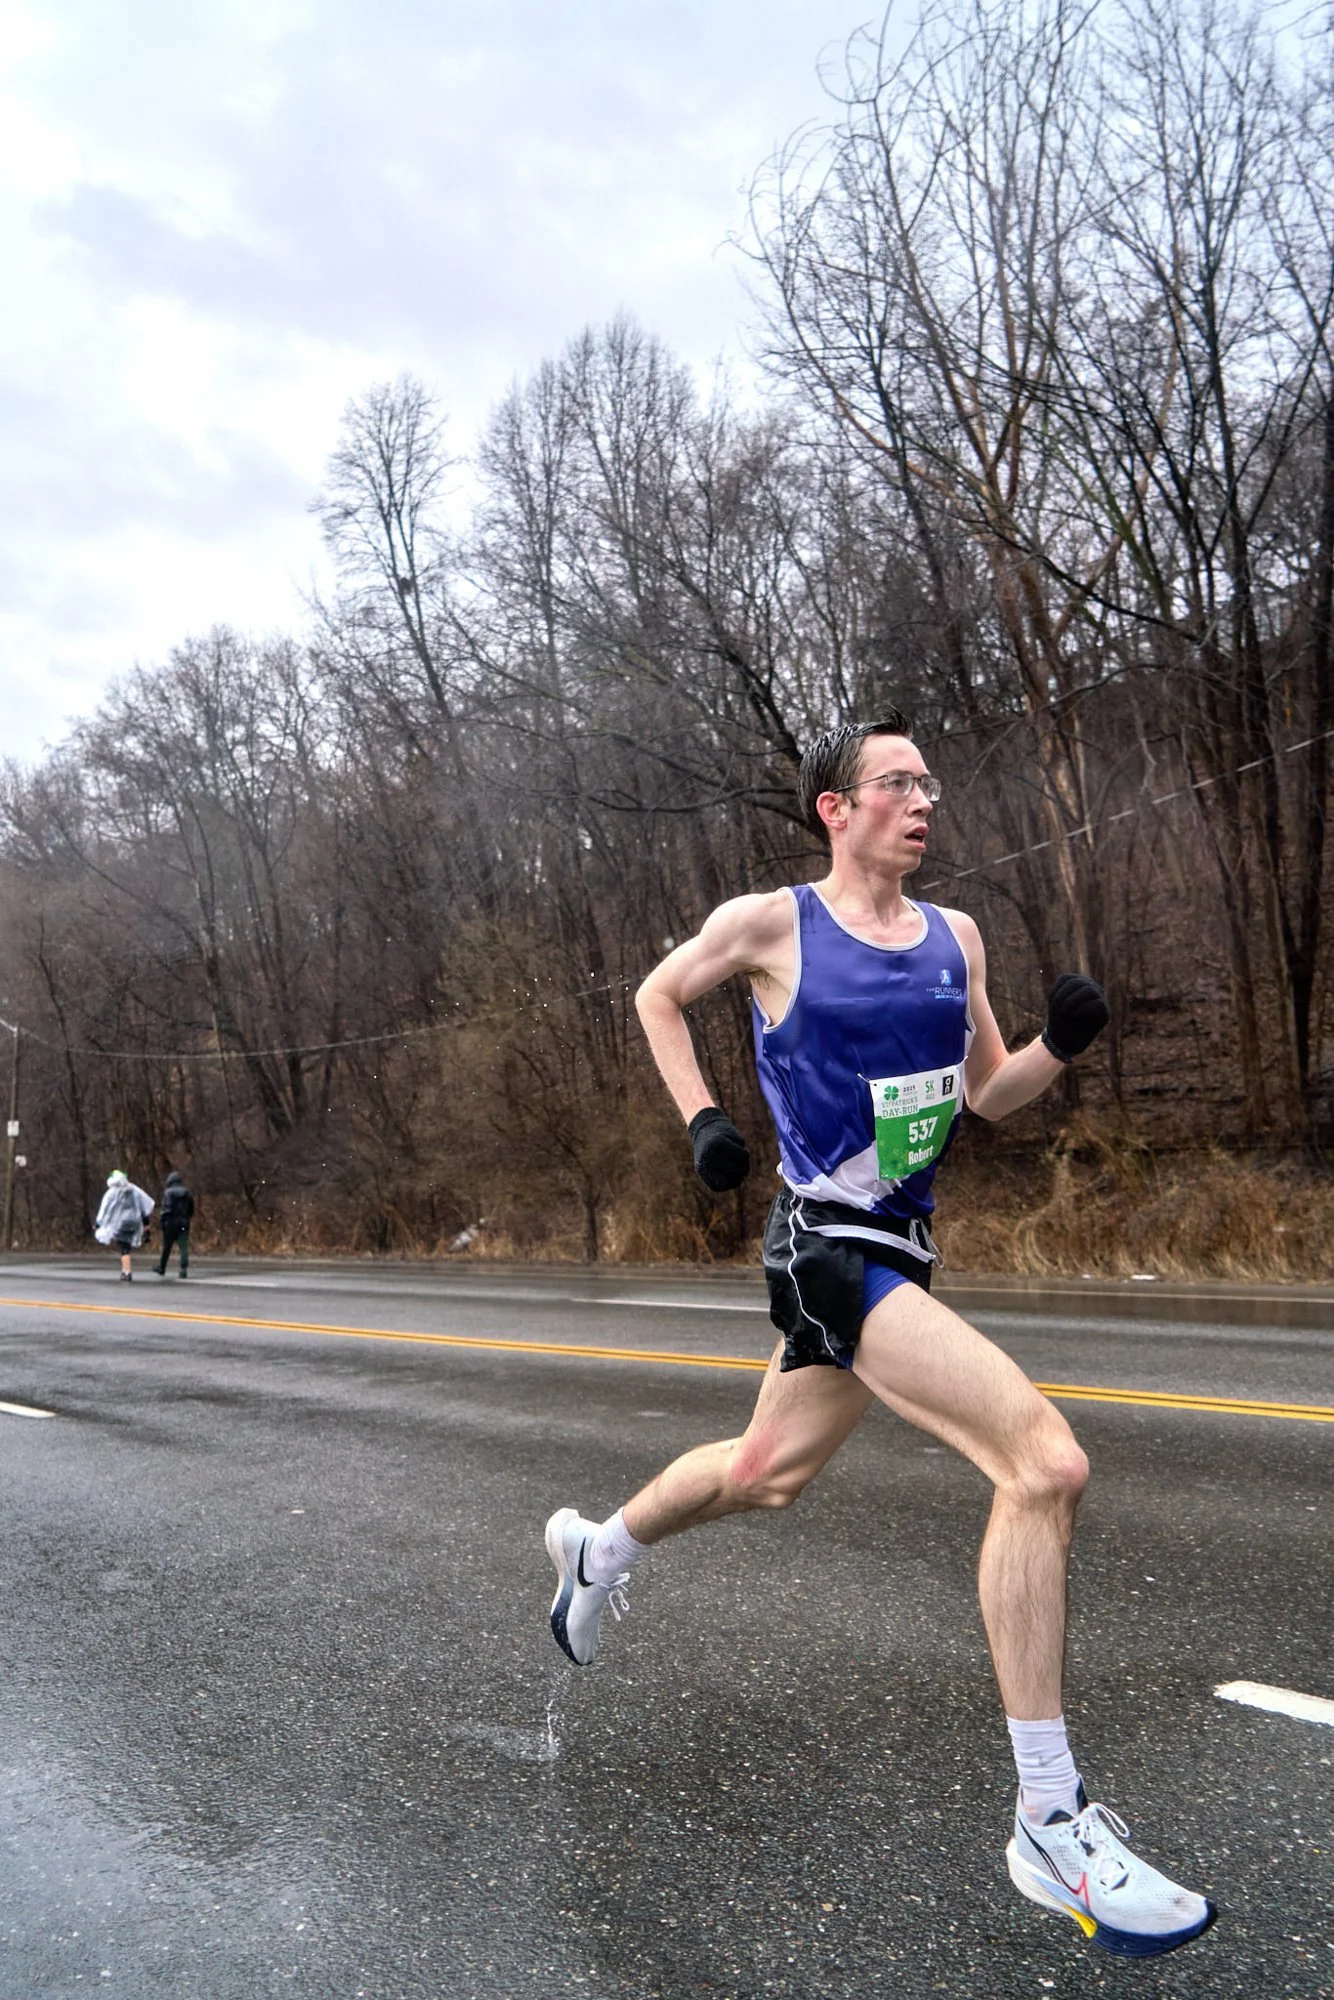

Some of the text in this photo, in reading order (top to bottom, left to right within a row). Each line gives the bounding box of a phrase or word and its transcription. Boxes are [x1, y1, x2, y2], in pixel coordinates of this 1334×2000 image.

[925, 1080, 935, 1093] 5K
[909, 1116, 938, 1144] 537
[909, 1145, 934, 1165] Robert
